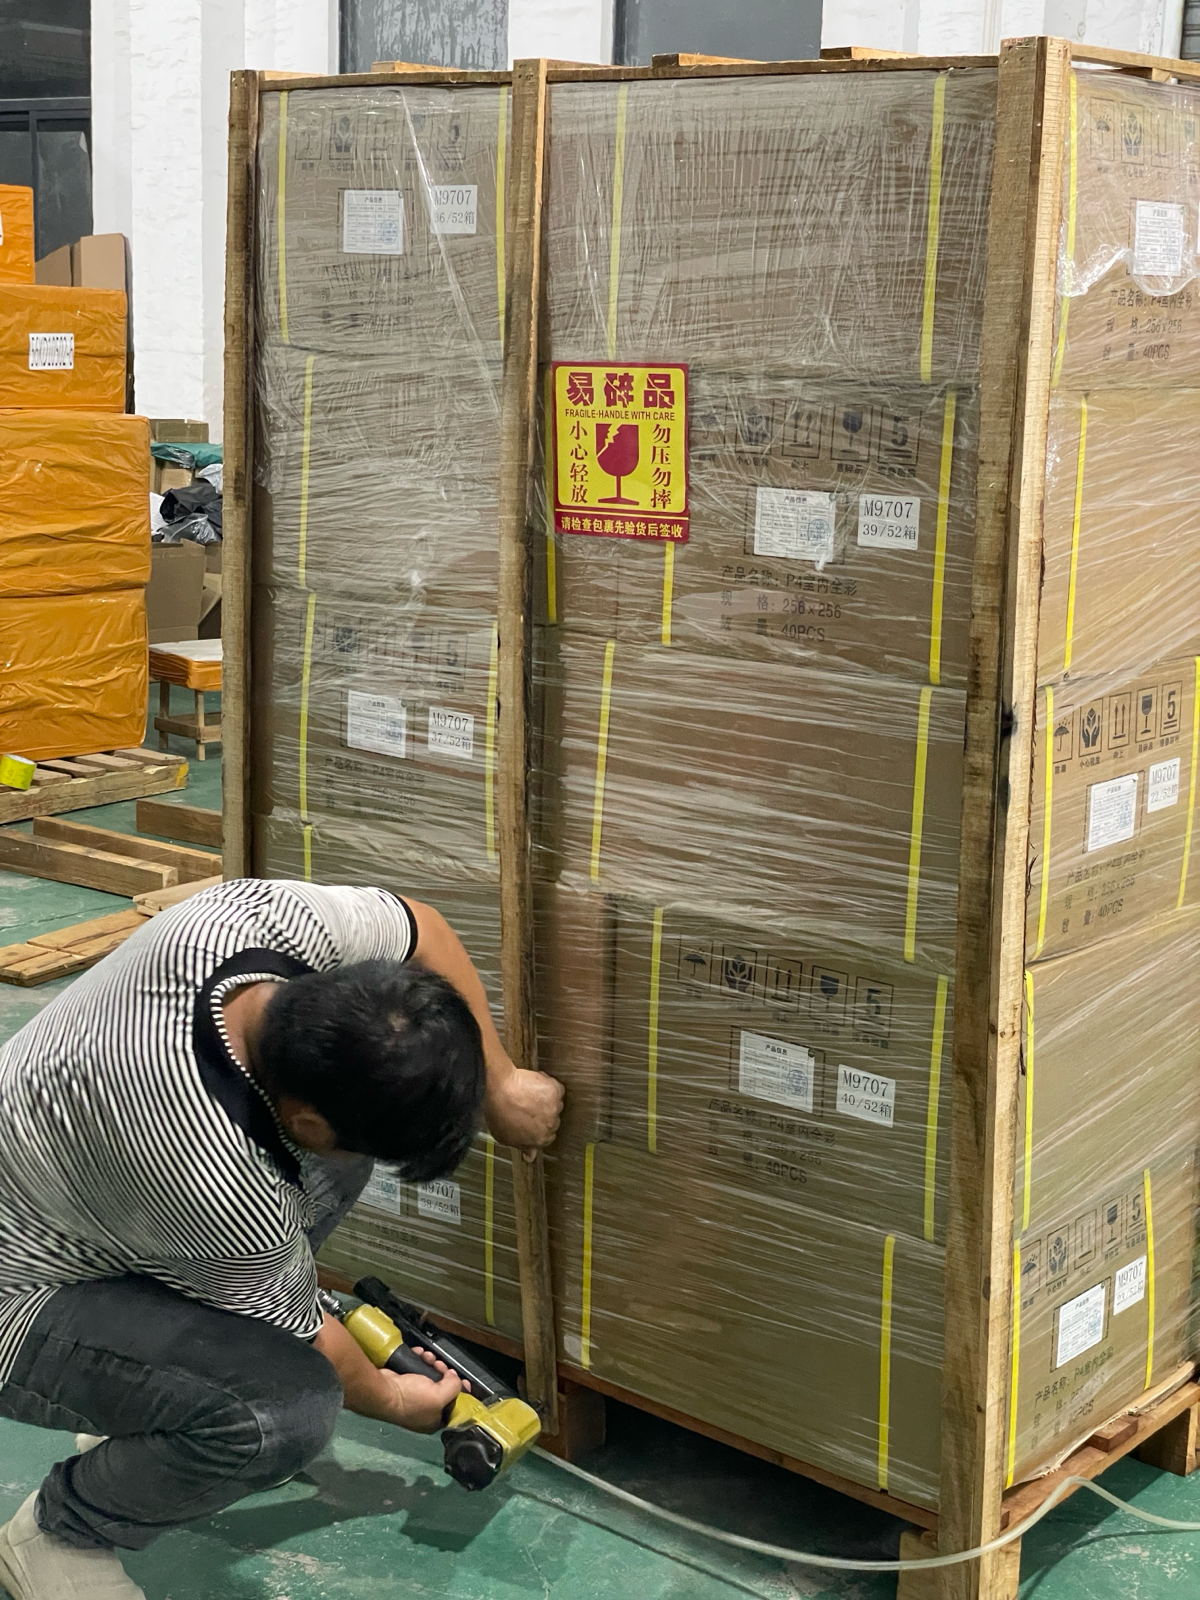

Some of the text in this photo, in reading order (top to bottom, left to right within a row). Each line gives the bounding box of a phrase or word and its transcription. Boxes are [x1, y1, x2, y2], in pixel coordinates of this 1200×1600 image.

[434, 190, 472, 206] M9707
[1143, 344, 1170, 360] 40PCS
[566, 372, 675, 409] 易碎品
[631, 411, 651, 420] WITH
[653, 412, 675, 421] CARE
[569, 420, 589, 504] 小心轻放
[650, 424, 672, 509] 勿压勿摔
[864, 499, 914, 519] M9707
[561, 516, 683, 538] 请检查包裹先验货后签收
[863, 524, 917, 541] 39/52箱
[783, 597, 842, 619] 256x256
[781, 624, 826, 642] 40PCS
[1167, 690, 1176, 720] 5
[432, 712, 469, 732] M9707
[431, 731, 471, 750] 37/52箱
[1151, 764, 1178, 786] M9707
[1098, 898, 1124, 918] 40PCS
[765, 1044, 788, 1055] 产品信息
[843, 1070, 889, 1097] M9707
[841, 1093, 892, 1118] 40/52箱
[1117, 1261, 1144, 1288] M9707
